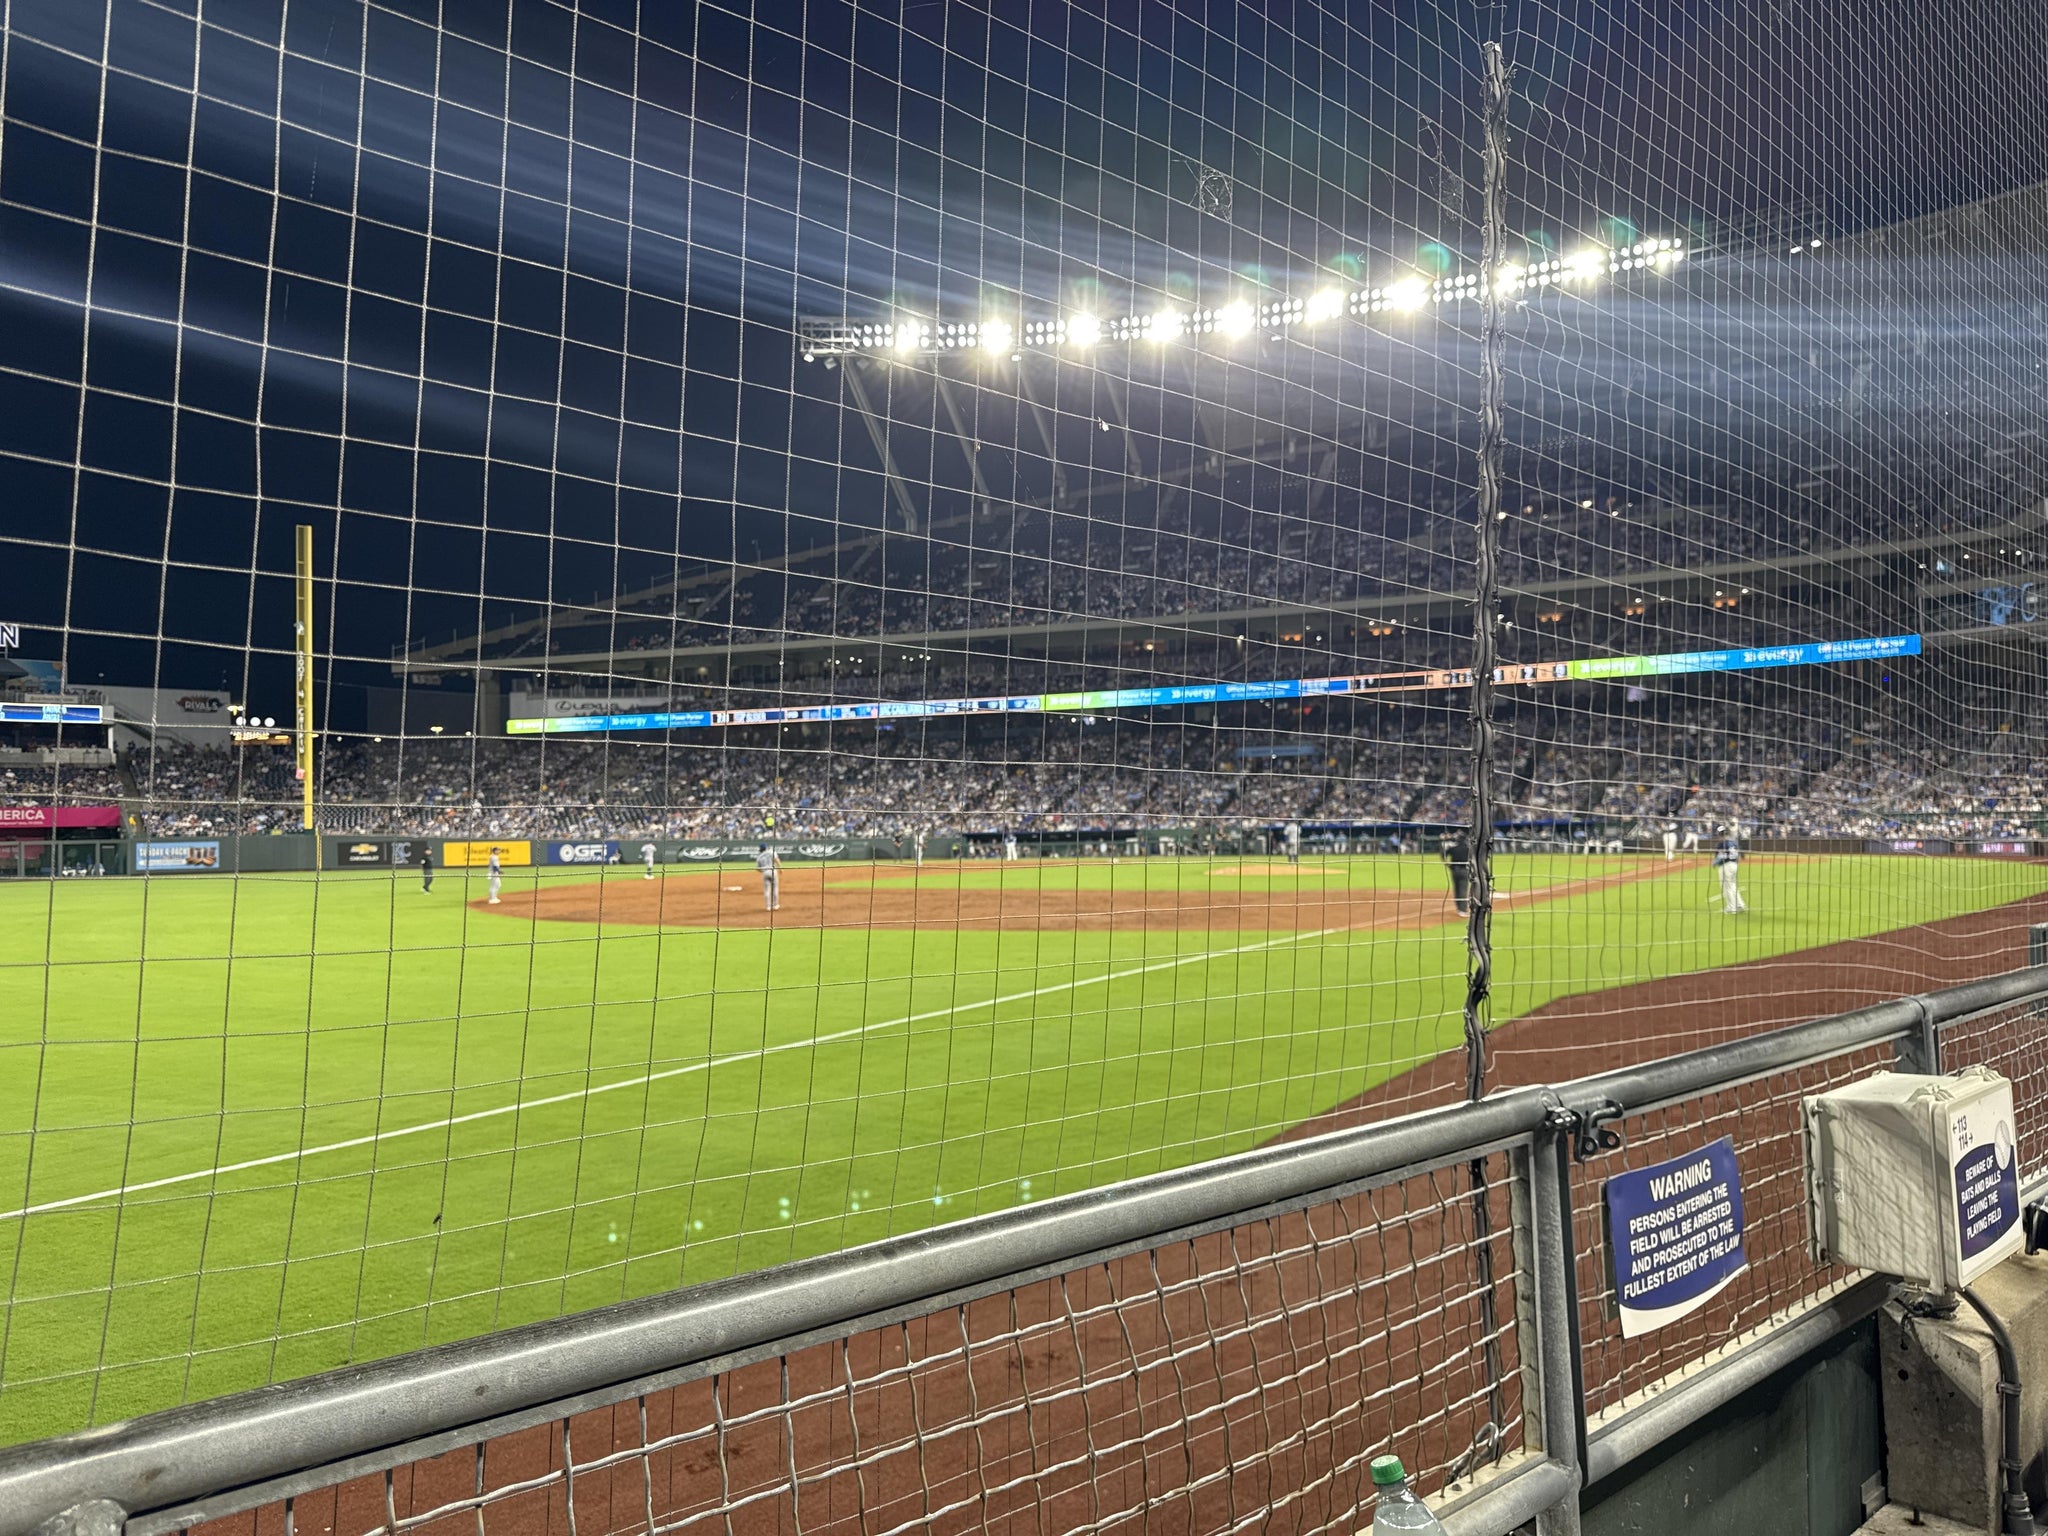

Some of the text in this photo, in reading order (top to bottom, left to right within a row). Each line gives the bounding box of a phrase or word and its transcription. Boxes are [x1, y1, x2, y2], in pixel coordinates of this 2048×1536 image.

[184, 701, 219, 711] RIVALS
[0, 809, 45, 821] ERICA
[1957, 1115, 1967, 1133] 113
[1958, 1132, 1968, 1151] 114
[1649, 1158, 1712, 1202] WARNING
[1965, 1155, 1994, 1183] BEWARE OF
[1961, 1171, 2002, 1205] BATS AND BALLS
[1629, 1183, 1728, 1235] PERSONS ENTERING THE
[1967, 1190, 1999, 1221] LEAVING THE
[1629, 1201, 1731, 1256] FIELD WILL BE ARRESTED
[1966, 1207, 2002, 1241] PLAYING FIELD
[1631, 1218, 1734, 1277] AND PROSECUTED TO THE
[1624, 1233, 1741, 1300] FULLEST EXTENT OF THE LAW
